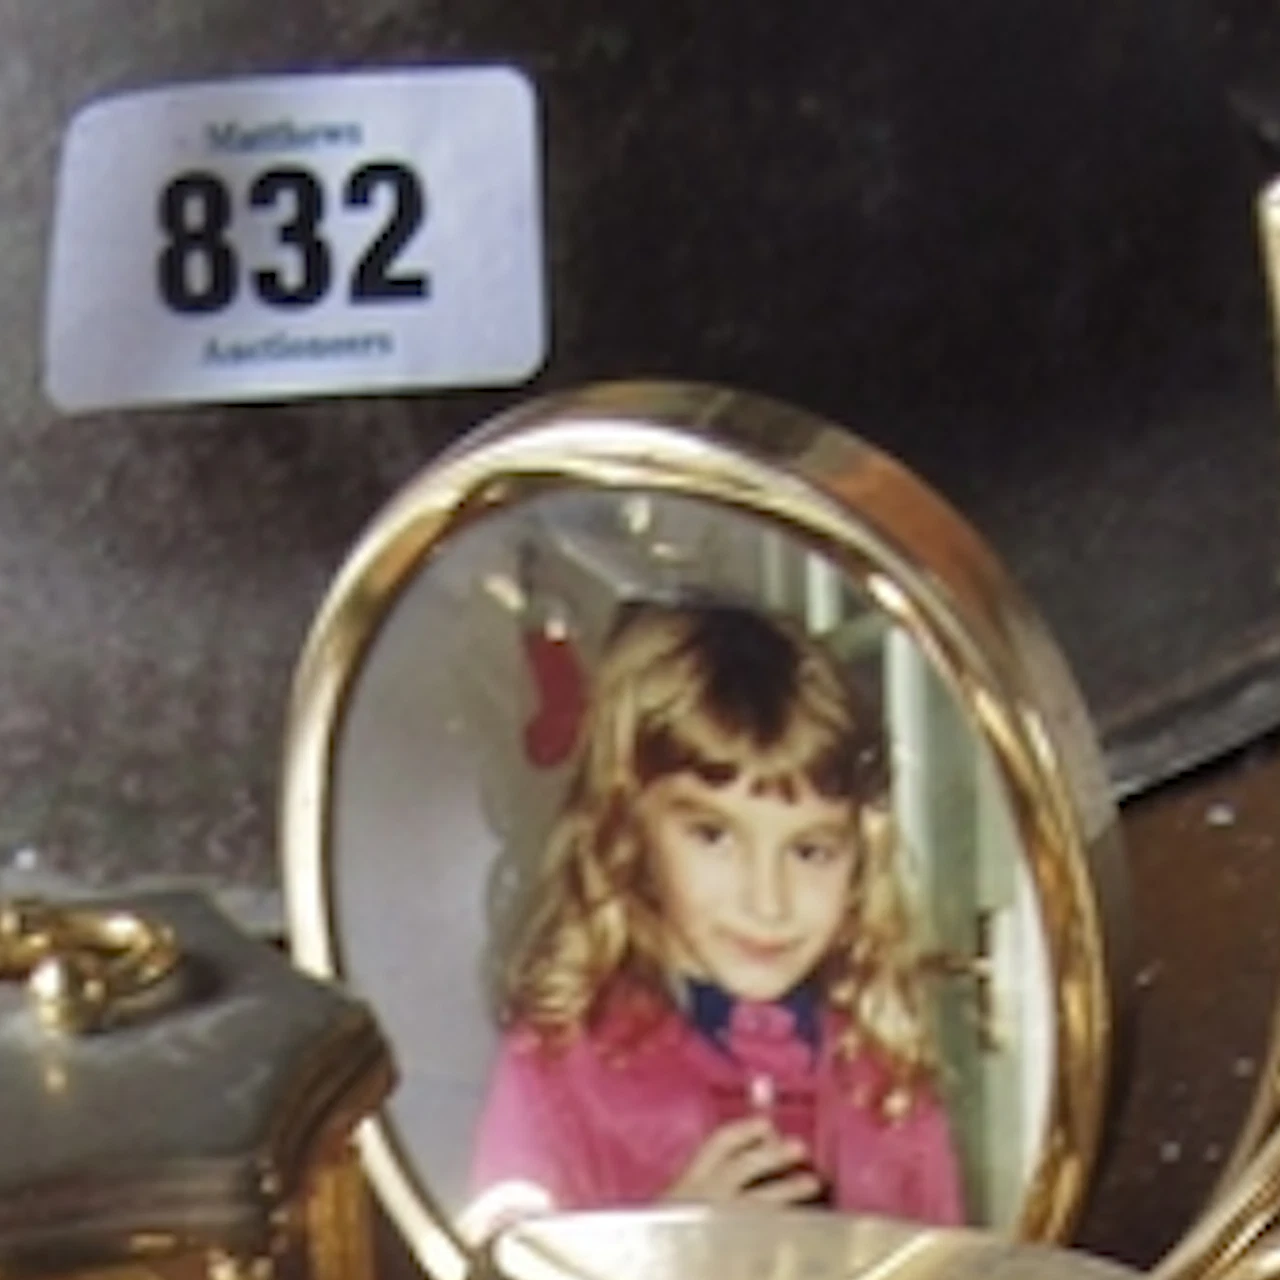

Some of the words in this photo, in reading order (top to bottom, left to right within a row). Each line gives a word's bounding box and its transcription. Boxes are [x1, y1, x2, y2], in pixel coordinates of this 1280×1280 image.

[205, 118, 363, 151] Matthews
[157, 160, 433, 315] 832
[203, 330, 395, 366] Auctioneers
